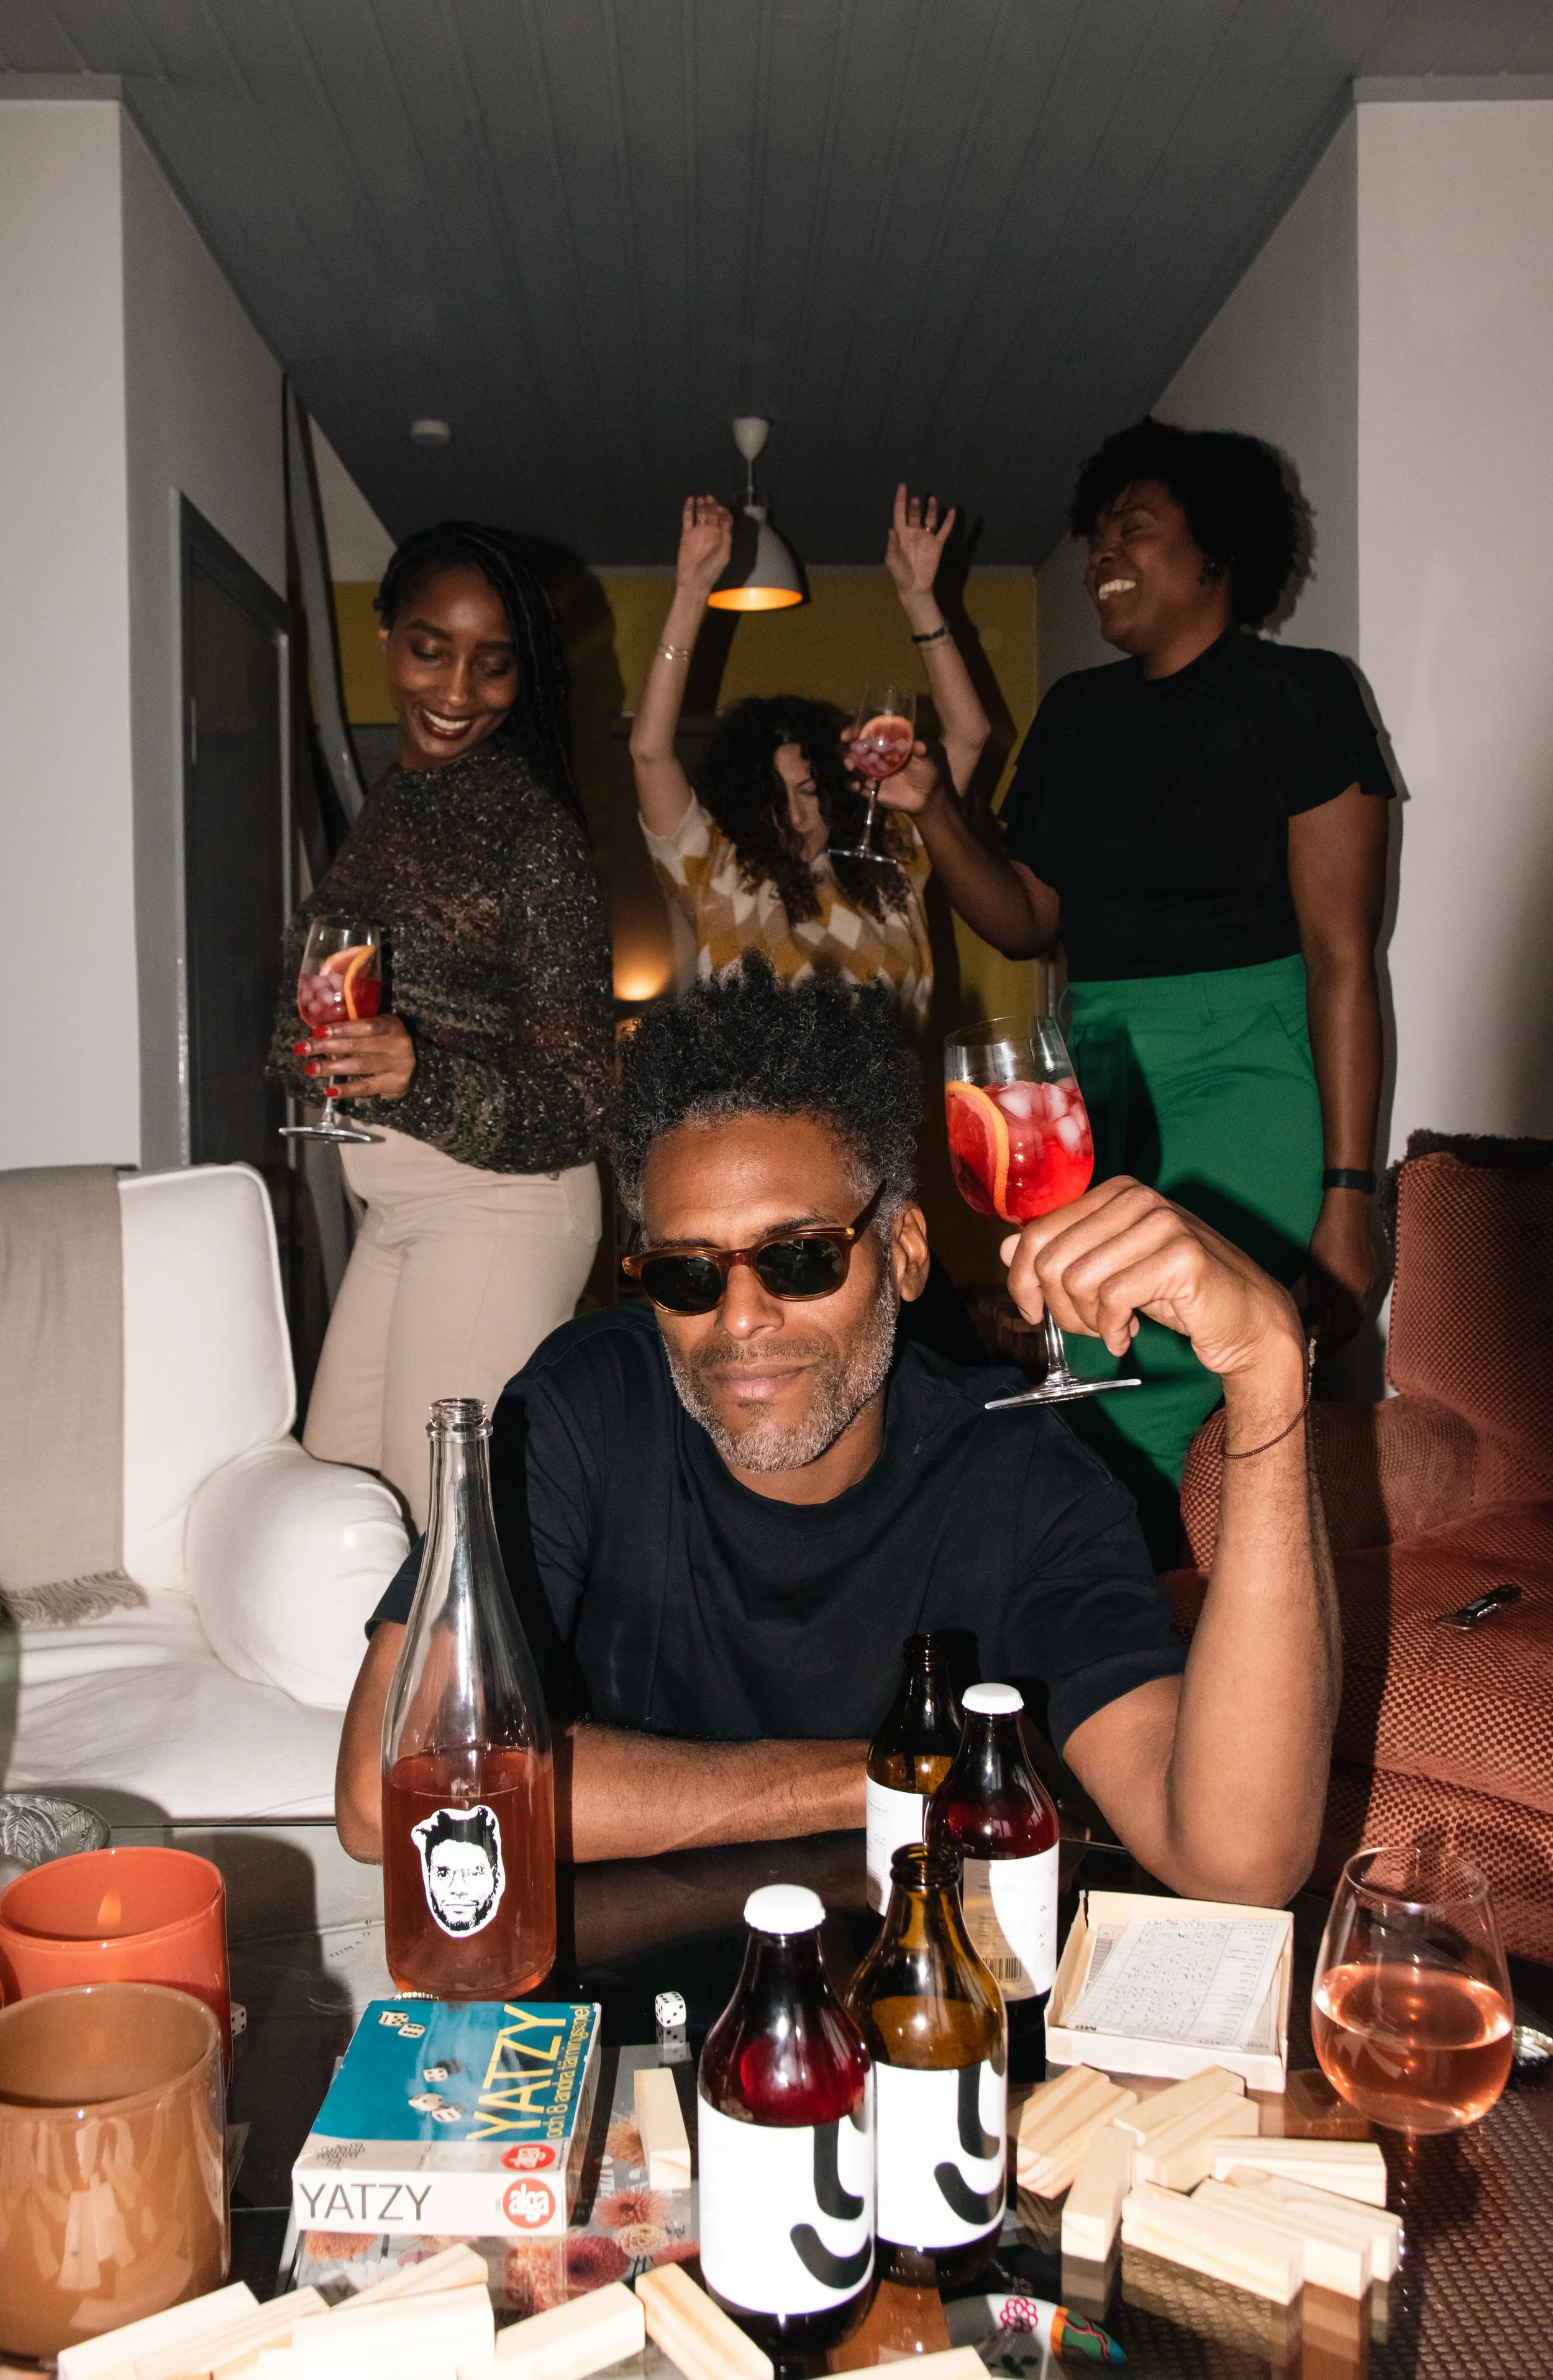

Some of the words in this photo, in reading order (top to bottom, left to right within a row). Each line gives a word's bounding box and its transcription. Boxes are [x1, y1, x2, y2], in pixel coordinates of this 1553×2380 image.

[466, 2004, 566, 2141] YATZY
[552, 2069, 575, 2103] andra
[542, 2115, 566, 2139] och
[546, 2104, 568, 2115] 8
[299, 2183, 432, 2221] YATZY
[508, 2183, 549, 2222] alga
